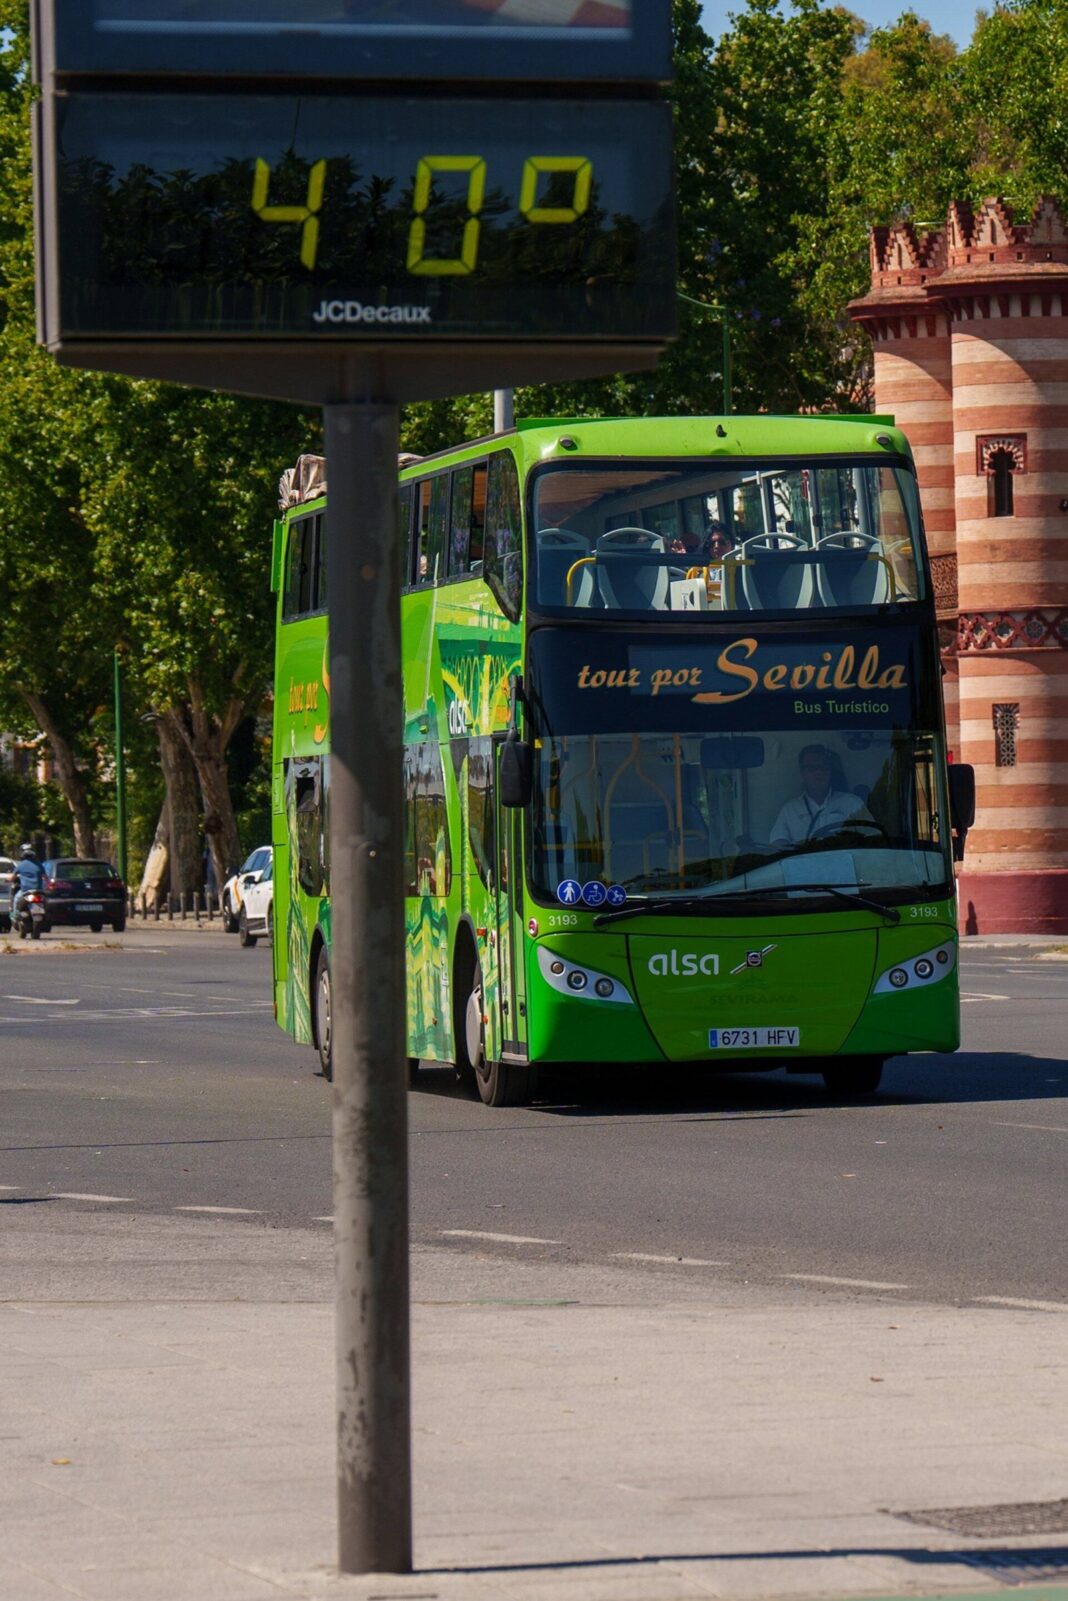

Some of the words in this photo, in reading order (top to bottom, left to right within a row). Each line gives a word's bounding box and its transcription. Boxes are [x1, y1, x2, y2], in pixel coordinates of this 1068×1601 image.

[312, 300, 432, 322] JCDecaux
[577, 665, 641, 689] tour
[650, 667, 703, 696] por
[691, 638, 908, 704] Sevilla
[794, 701, 822, 714] Bus
[826, 700, 889, 713] Turístico
[548, 914, 578, 926] 3193
[910, 906, 938, 918] 3193
[648, 949, 719, 976] alsa
[721, 1030, 758, 1046] 6731
[767, 1029, 796, 1045] HFV
